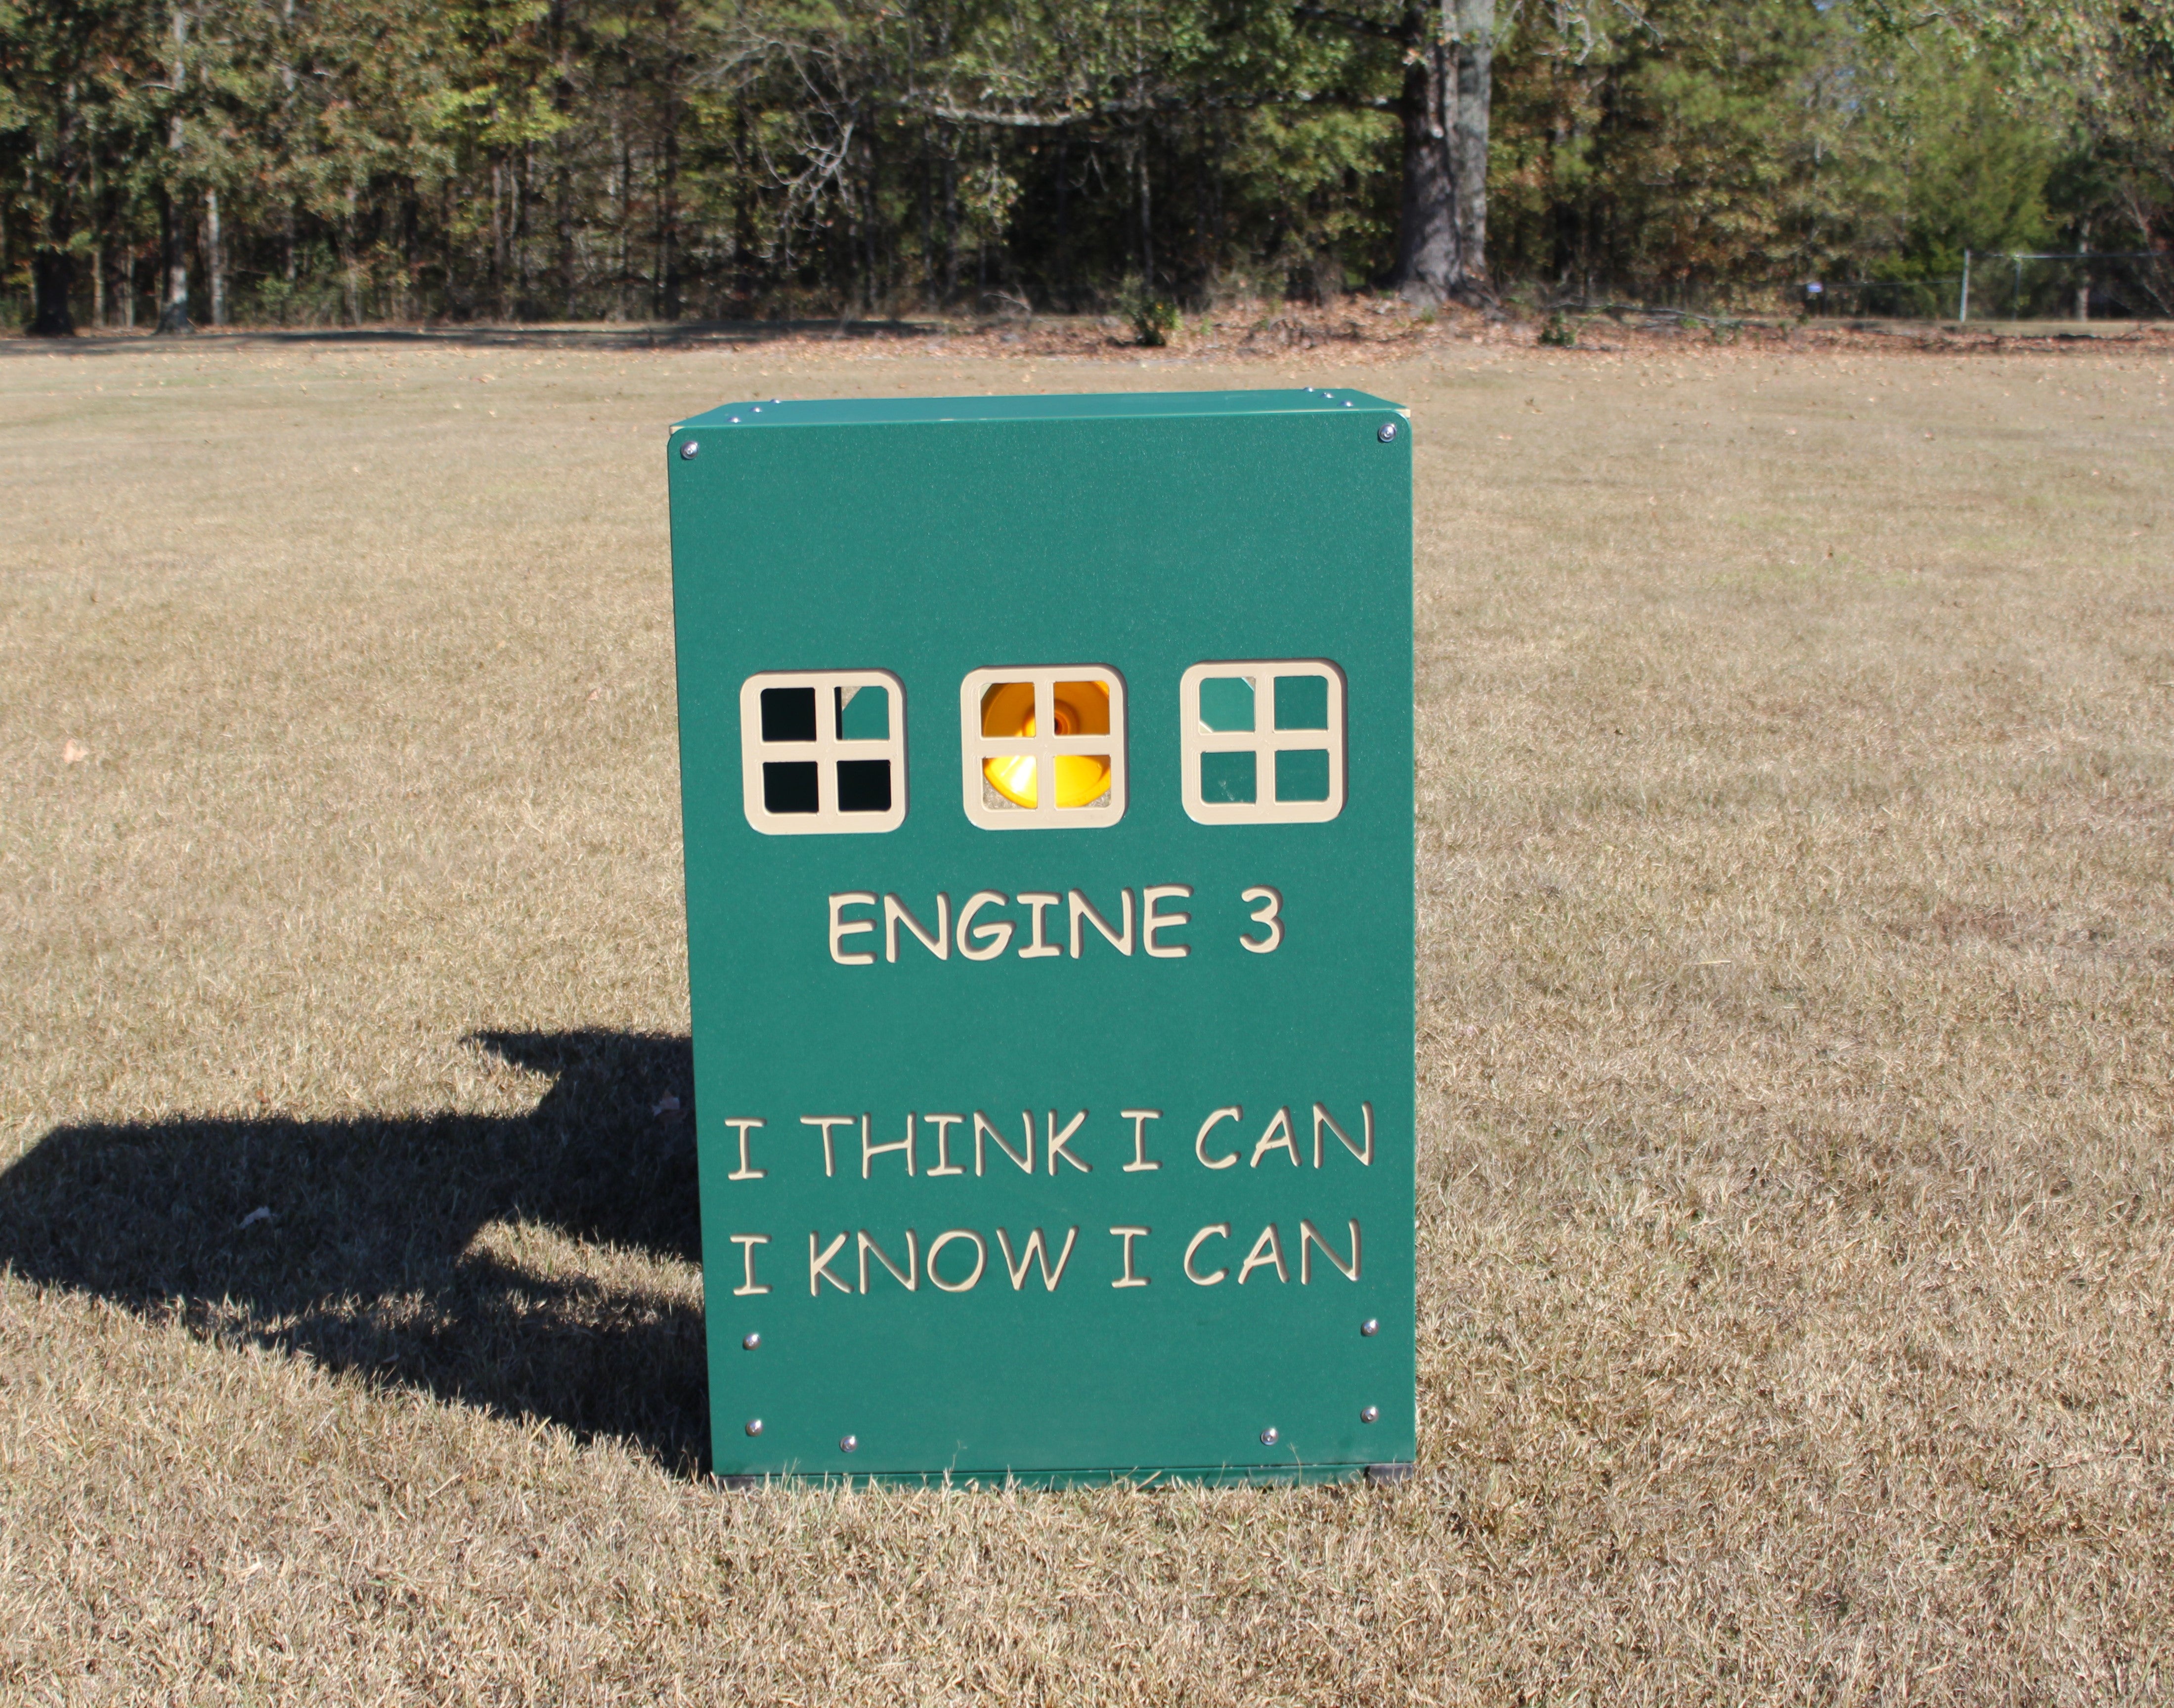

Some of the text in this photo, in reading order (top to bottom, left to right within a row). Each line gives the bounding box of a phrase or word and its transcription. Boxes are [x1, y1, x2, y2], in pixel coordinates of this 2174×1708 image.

[827, 884, 1284, 965] ENGINE 3
[723, 1104, 1373, 1181] I THINK I CAN
[729, 1221, 1359, 1297] I KNOW I CAN
